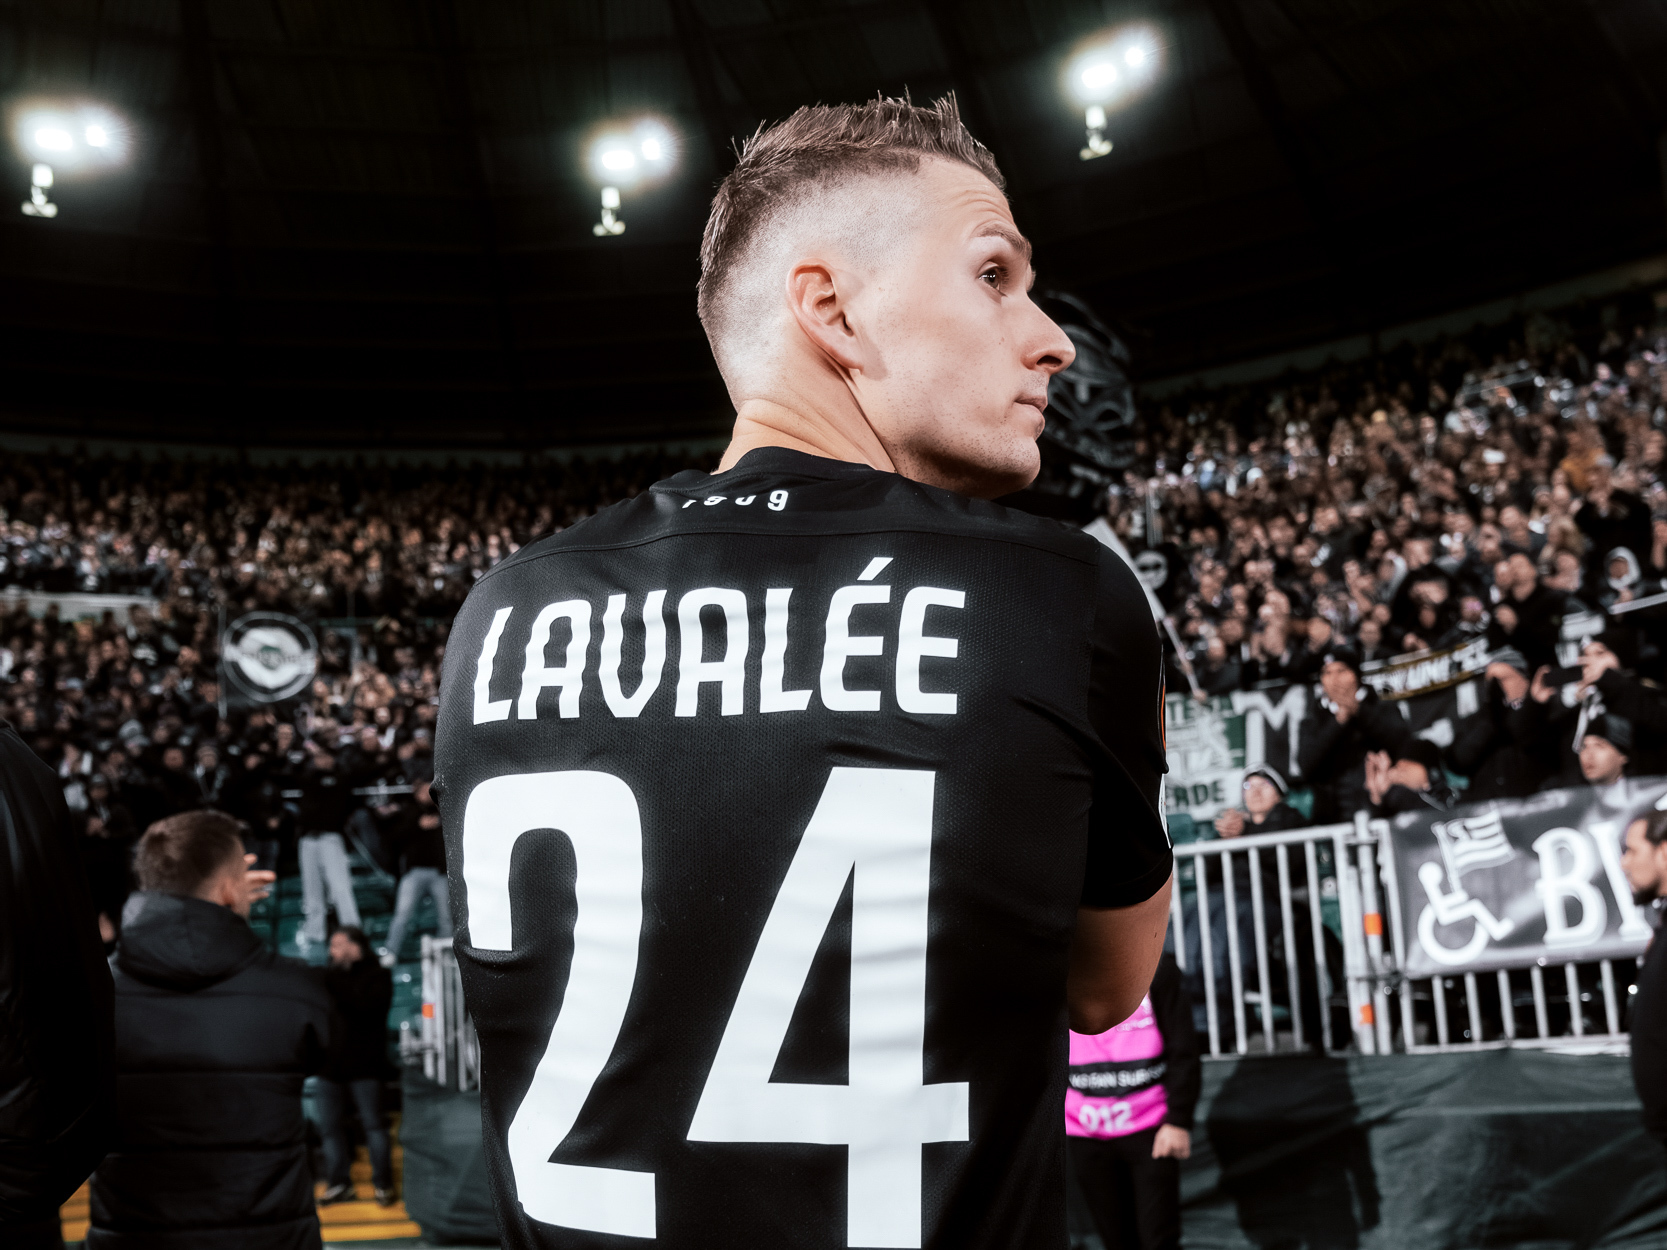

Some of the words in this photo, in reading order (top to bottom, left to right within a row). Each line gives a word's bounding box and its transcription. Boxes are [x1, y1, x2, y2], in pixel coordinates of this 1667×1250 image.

[472, 556, 966, 725] LAVALÉE
[462, 766, 970, 1249] 24
[1078, 1101, 1135, 1133] 012
